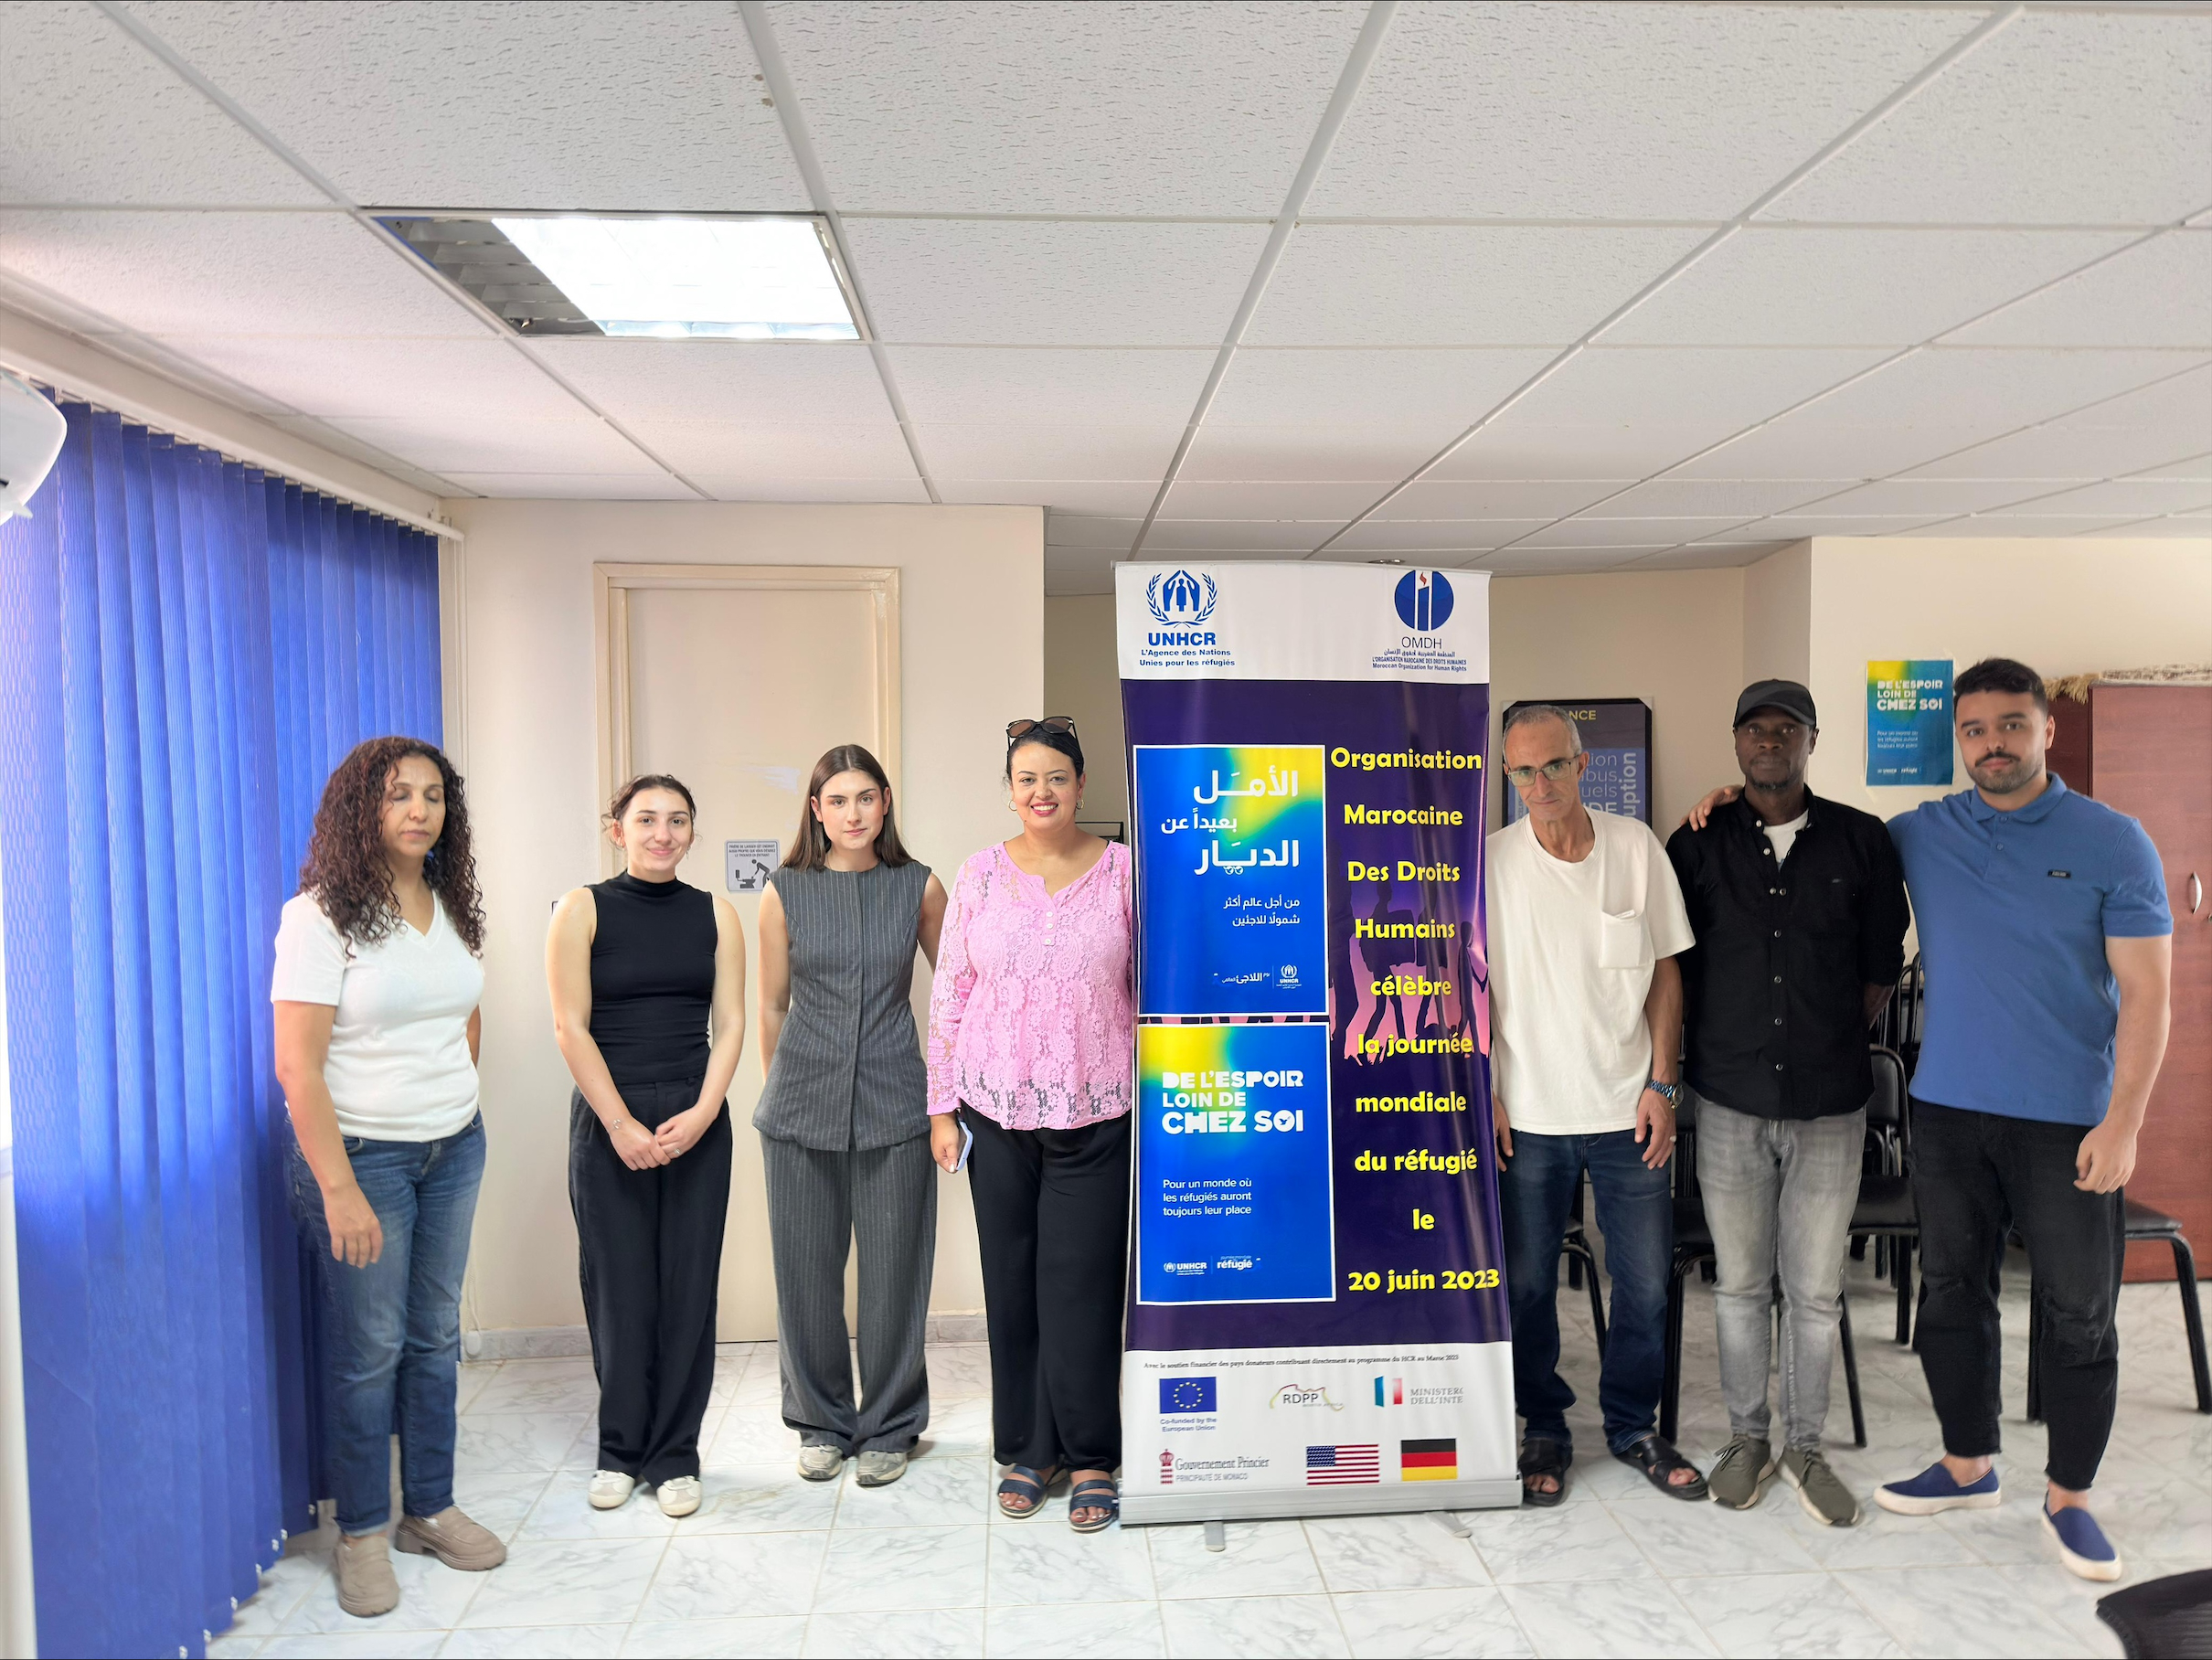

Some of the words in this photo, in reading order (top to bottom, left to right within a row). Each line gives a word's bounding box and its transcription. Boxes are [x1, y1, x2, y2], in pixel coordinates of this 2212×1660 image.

[1148, 633, 1216, 645] UNHCR
[1401, 636, 1442, 649] OMDH
[1141, 649, 1179, 657] L'Agence
[1877, 680, 1893, 689] DE
[1877, 690, 1900, 698] LOIN
[1920, 697, 1942, 710] SOI
[1569, 709, 1596, 720] NCE
[1331, 747, 1482, 771] Organisation
[1587, 753, 1617, 767] ion
[1581, 783, 1617, 798] uels
[1619, 752, 1641, 816] uption
[1343, 803, 1463, 826] Marocaine
[1161, 816, 1189, 835] عن
[1347, 861, 1389, 882] Des
[1397, 861, 1461, 883] Droits
[1223, 894, 1240, 910] أكثر
[1243, 897, 1262, 910] عالم
[1264, 894, 1281, 909] أجل
[1284, 899, 1300, 909] من
[1232, 915, 1267, 927] للاجئين
[1354, 918, 1455, 939] Humains
[1370, 974, 1452, 996] célèbre
[1357, 1033, 1380, 1054] la
[1387, 1032, 1473, 1057] journée
[1162, 1072, 1195, 1090] DE
[1200, 1069, 1304, 1089] L'ESPOIR
[1162, 1092, 1212, 1108] LOIN
[1218, 1092, 1246, 1107] DE
[1356, 1091, 1466, 1112] mondiale
[1162, 1111, 1246, 1134] CHEZ
[1253, 1110, 1304, 1133] SOI
[1355, 1150, 1387, 1172] du
[1394, 1148, 1478, 1175] réfugié
[1163, 1179, 1186, 1188] Pour
[1203, 1178, 1237, 1187] monde
[1239, 1178, 1252, 1187] où
[1163, 1193, 1177, 1202] les
[1180, 1192, 1218, 1204] réfugiés
[1220, 1192, 1252, 1201] auront
[1163, 1207, 1202, 1218] toujours
[1205, 1206, 1223, 1215] leur
[1225, 1206, 1252, 1216] place
[1412, 1208, 1435, 1230] le
[1217, 1260, 1252, 1271] réfugié
[1348, 1272, 1381, 1291] 20
[1387, 1268, 1436, 1293] juin
[1441, 1269, 1500, 1291] 2023
[1283, 1393, 1319, 1404] RDPP
[1175, 1458, 1236, 1471] Gouvernement
[1238, 1456, 1270, 1468] Princier
[1223, 1473, 1249, 1481] MONACO
